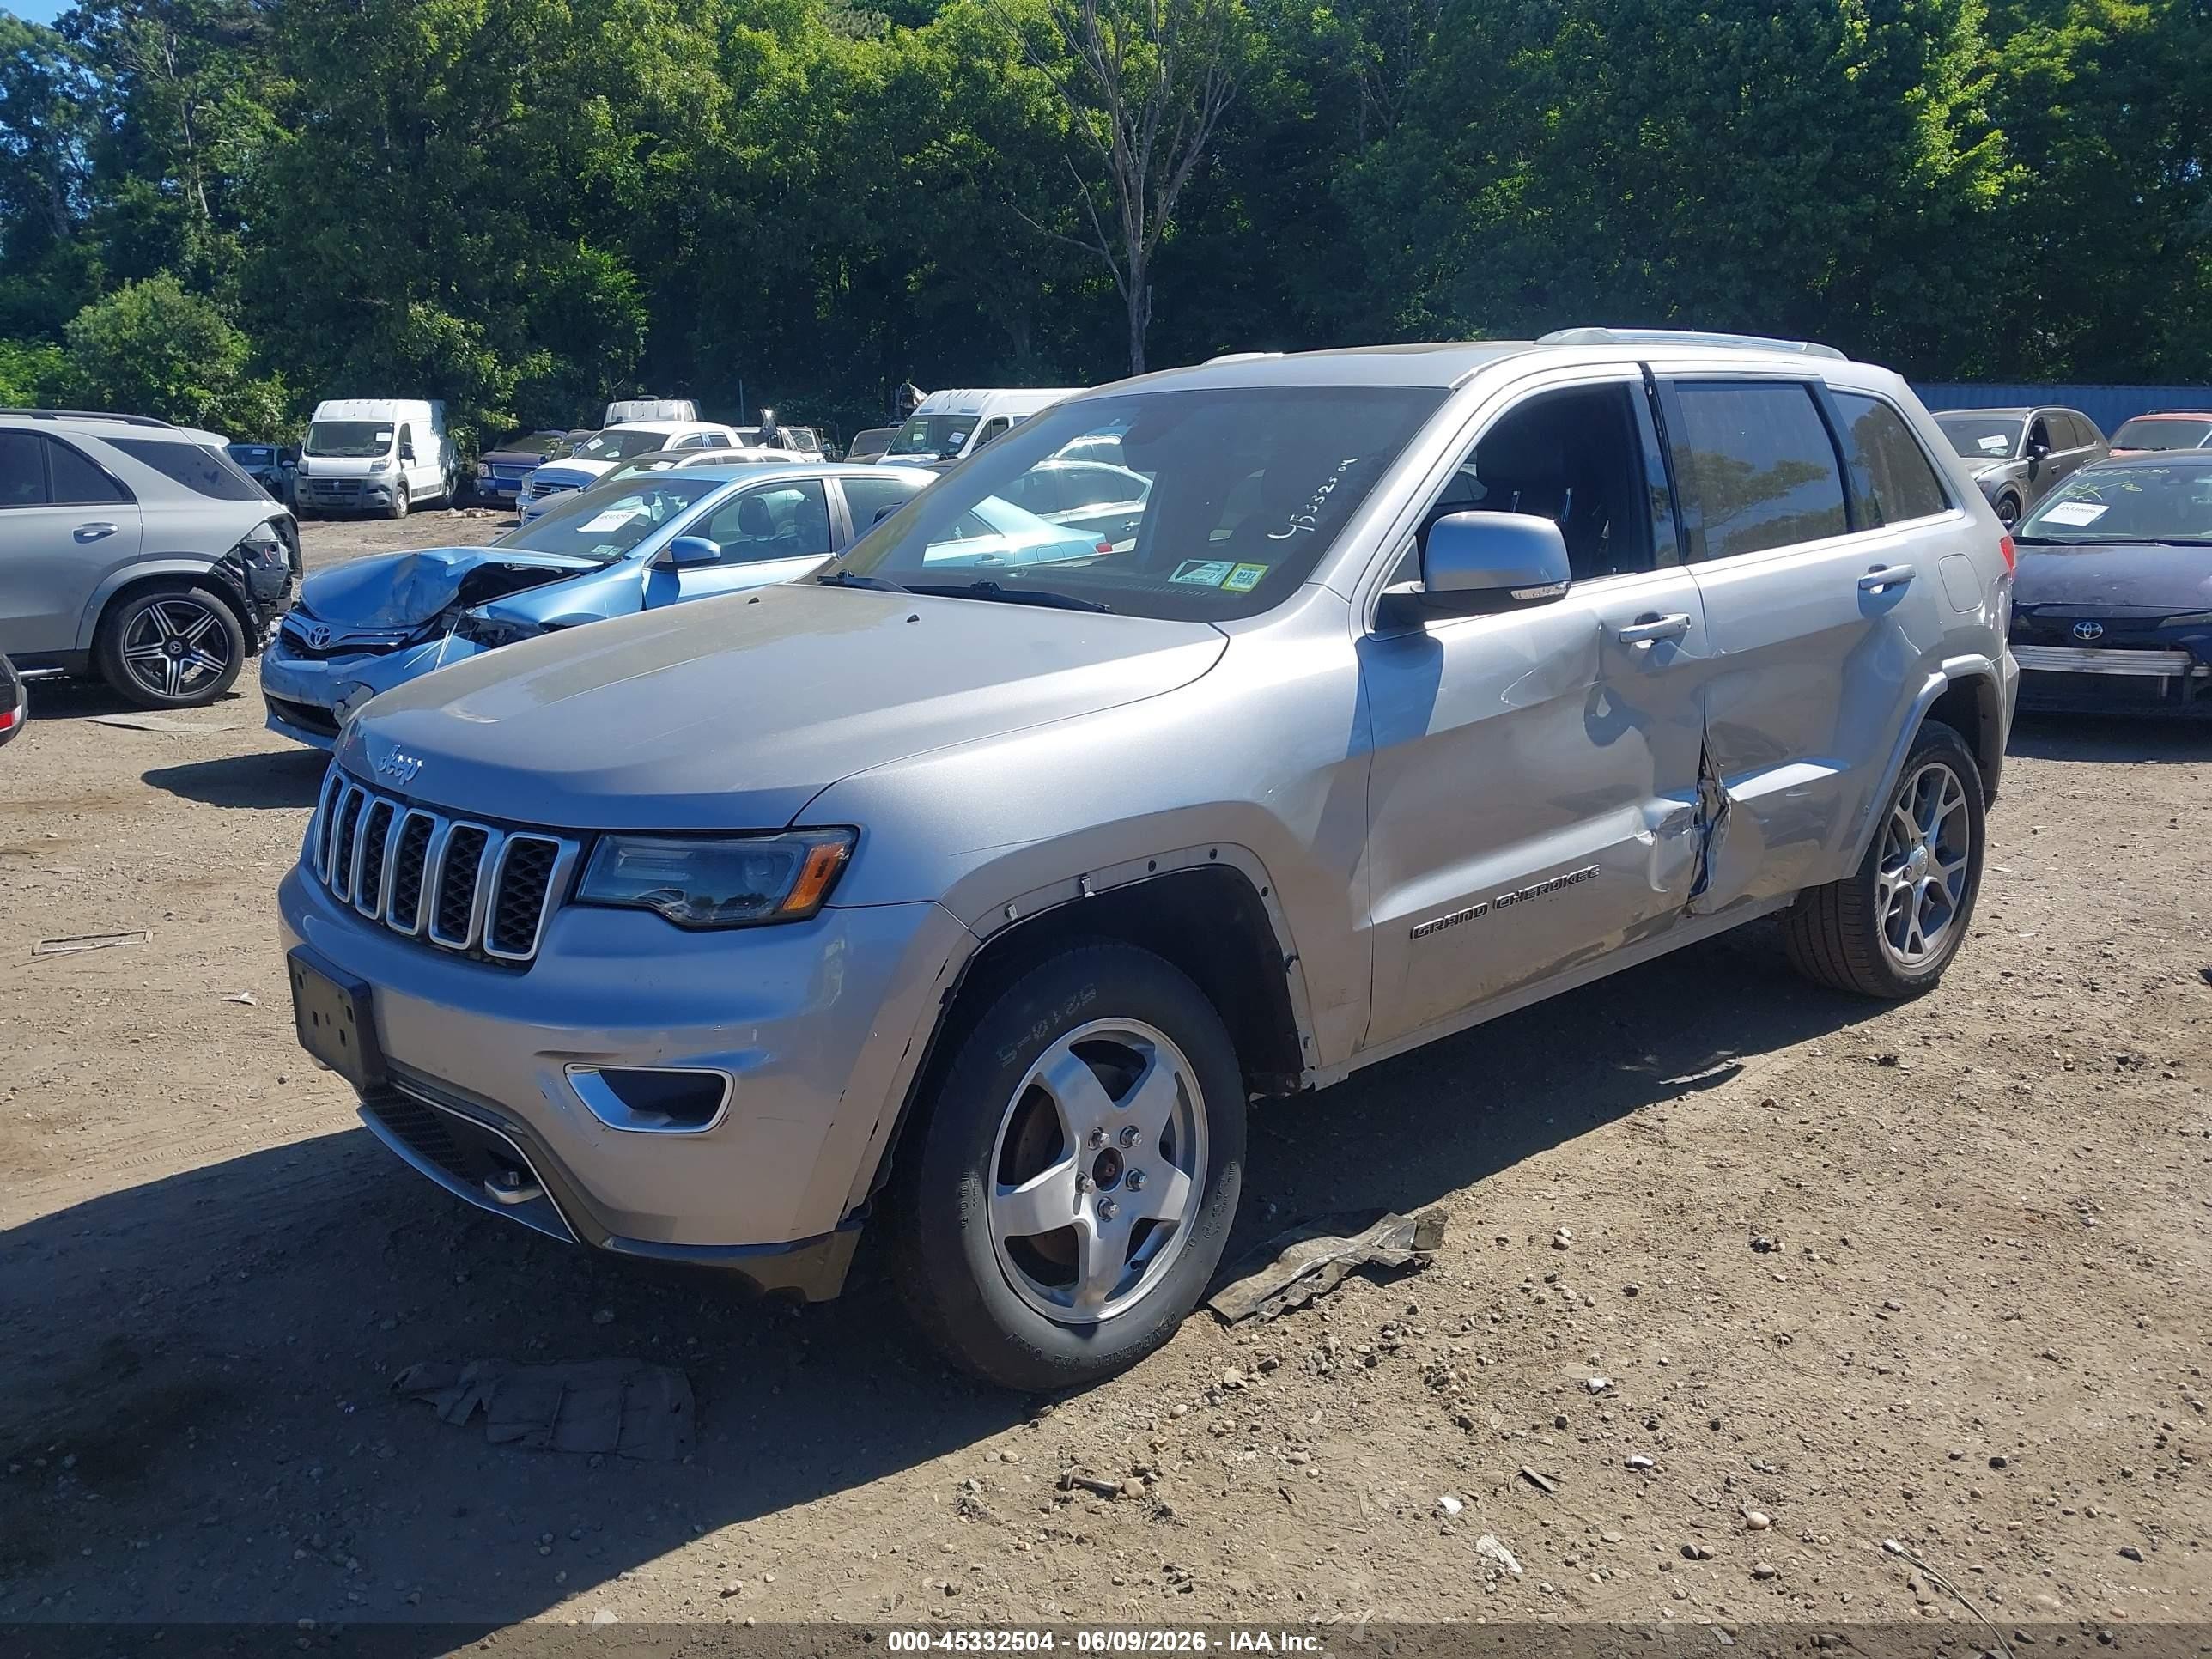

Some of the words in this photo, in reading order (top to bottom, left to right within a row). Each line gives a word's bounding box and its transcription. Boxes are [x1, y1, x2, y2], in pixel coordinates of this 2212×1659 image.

[378, 744, 423, 786] Jeep
[1411, 902, 1489, 940] GRAND
[1492, 864, 1601, 910] CHEROKEE
